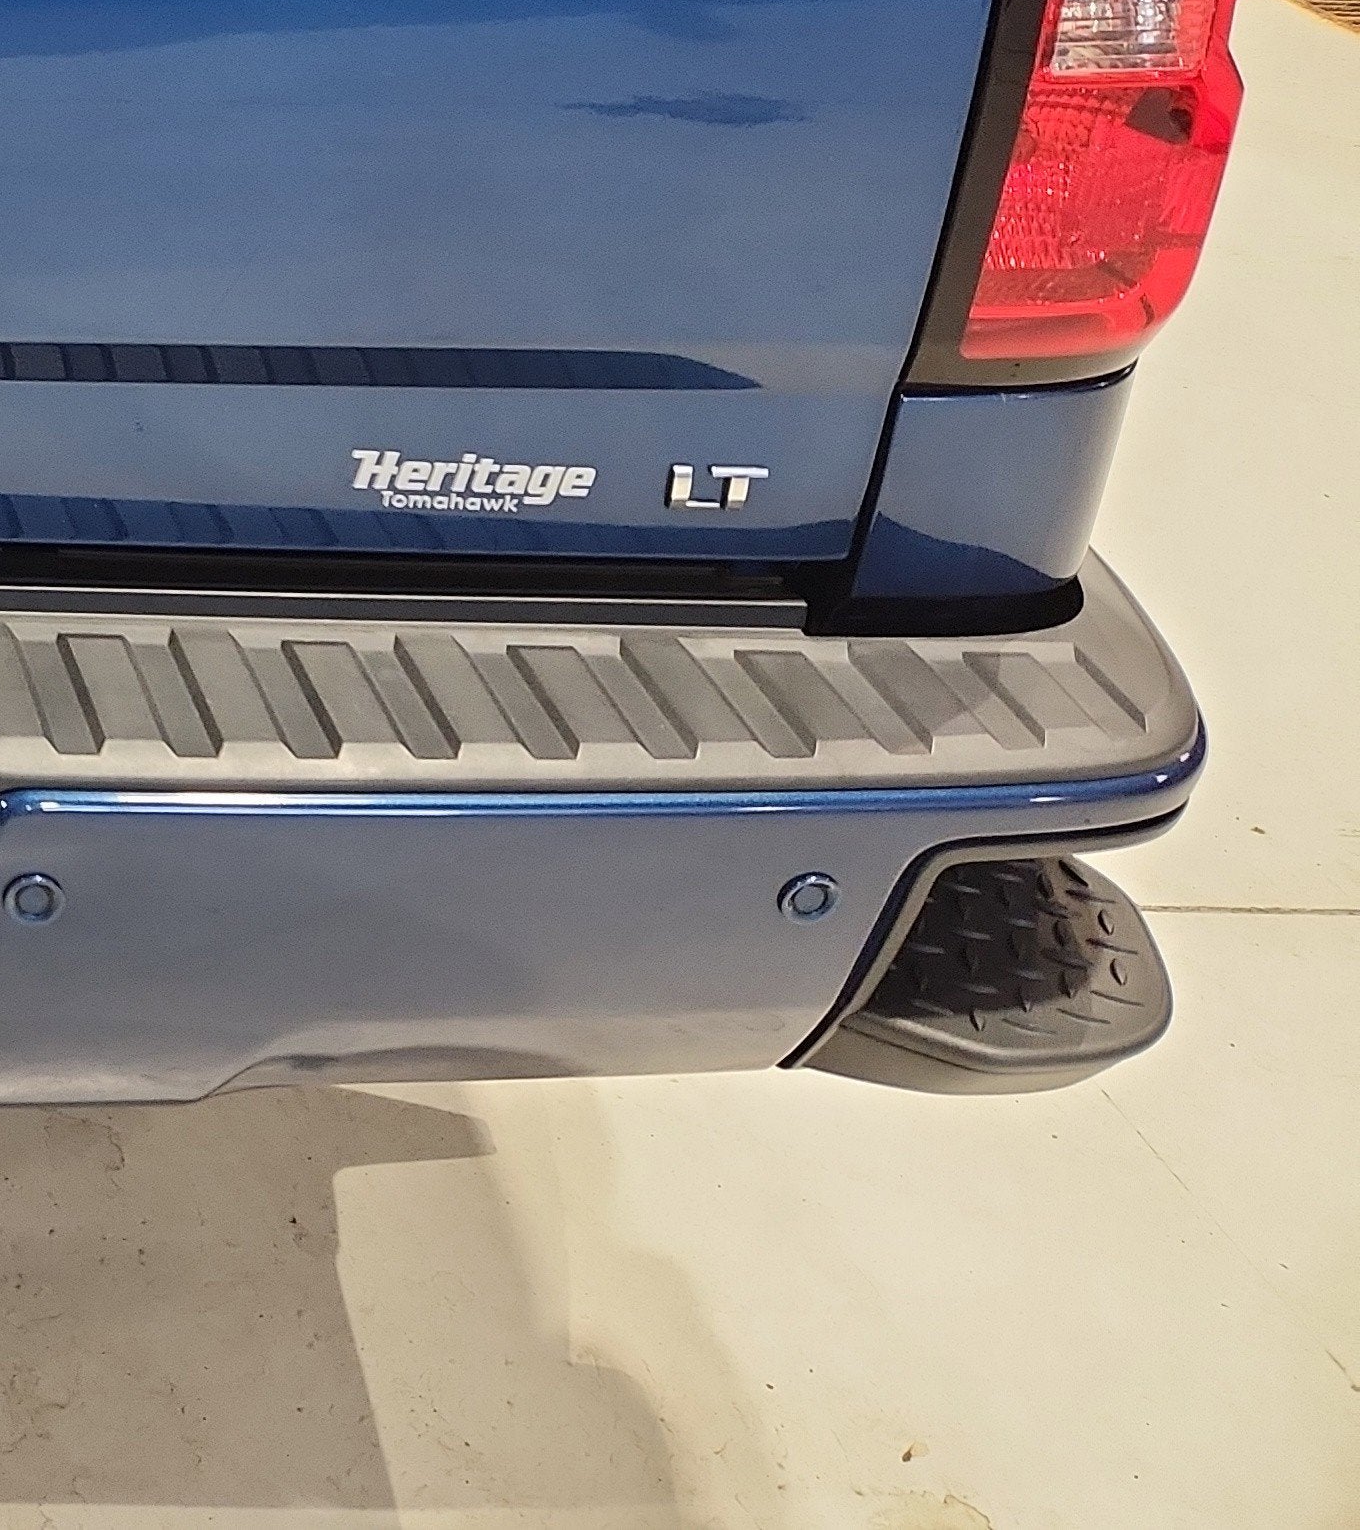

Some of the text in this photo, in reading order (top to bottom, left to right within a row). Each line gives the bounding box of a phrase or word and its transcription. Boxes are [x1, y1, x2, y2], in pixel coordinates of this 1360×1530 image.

[351, 448, 597, 506] Heritage
[668, 464, 770, 509] LT
[381, 490, 519, 513] Tomahawk
